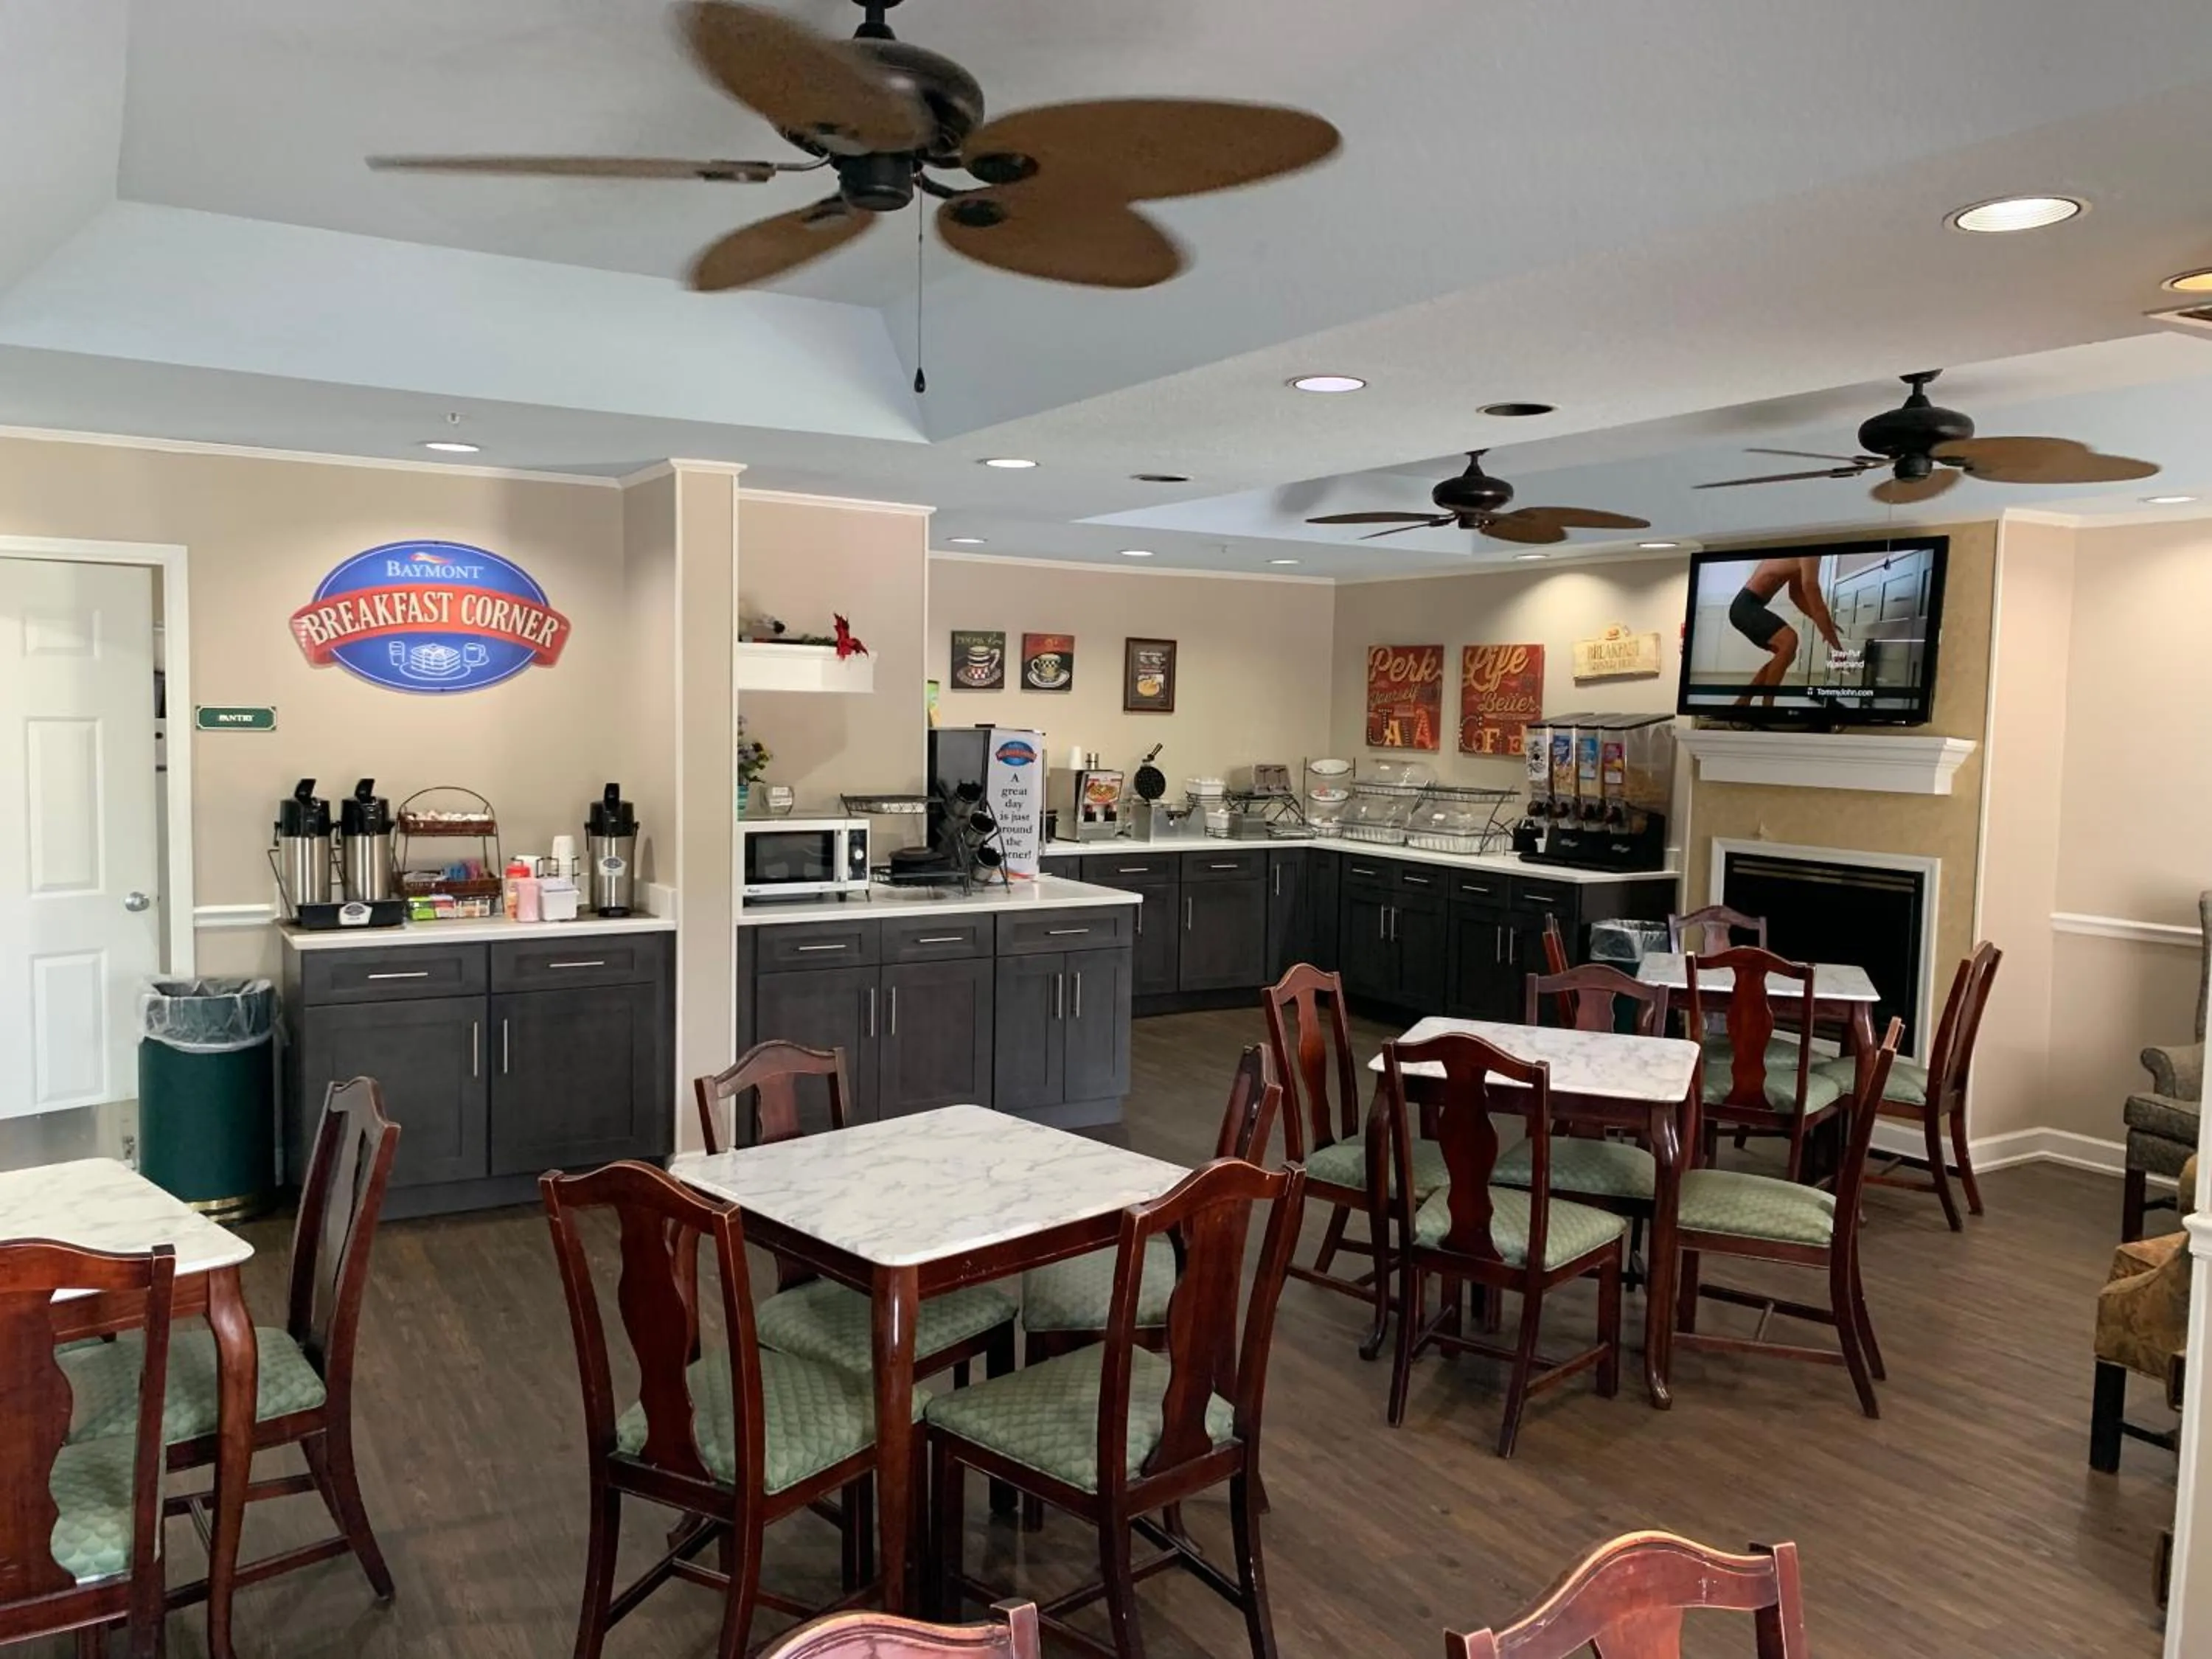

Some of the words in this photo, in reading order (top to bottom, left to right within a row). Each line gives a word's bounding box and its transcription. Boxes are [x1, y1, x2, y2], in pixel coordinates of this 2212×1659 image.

[387, 560, 484, 579] BAYMONT
[304, 591, 452, 645] BREAKFAST
[460, 594, 558, 647] CORNER
[1369, 646, 1442, 682] Perk
[1011, 773, 1019, 782] A
[1001, 788, 1027, 797] great
[1005, 799, 1023, 810] day
[999, 812, 1009, 821] is
[1012, 812, 1030, 823] just
[1006, 838, 1022, 846] the
